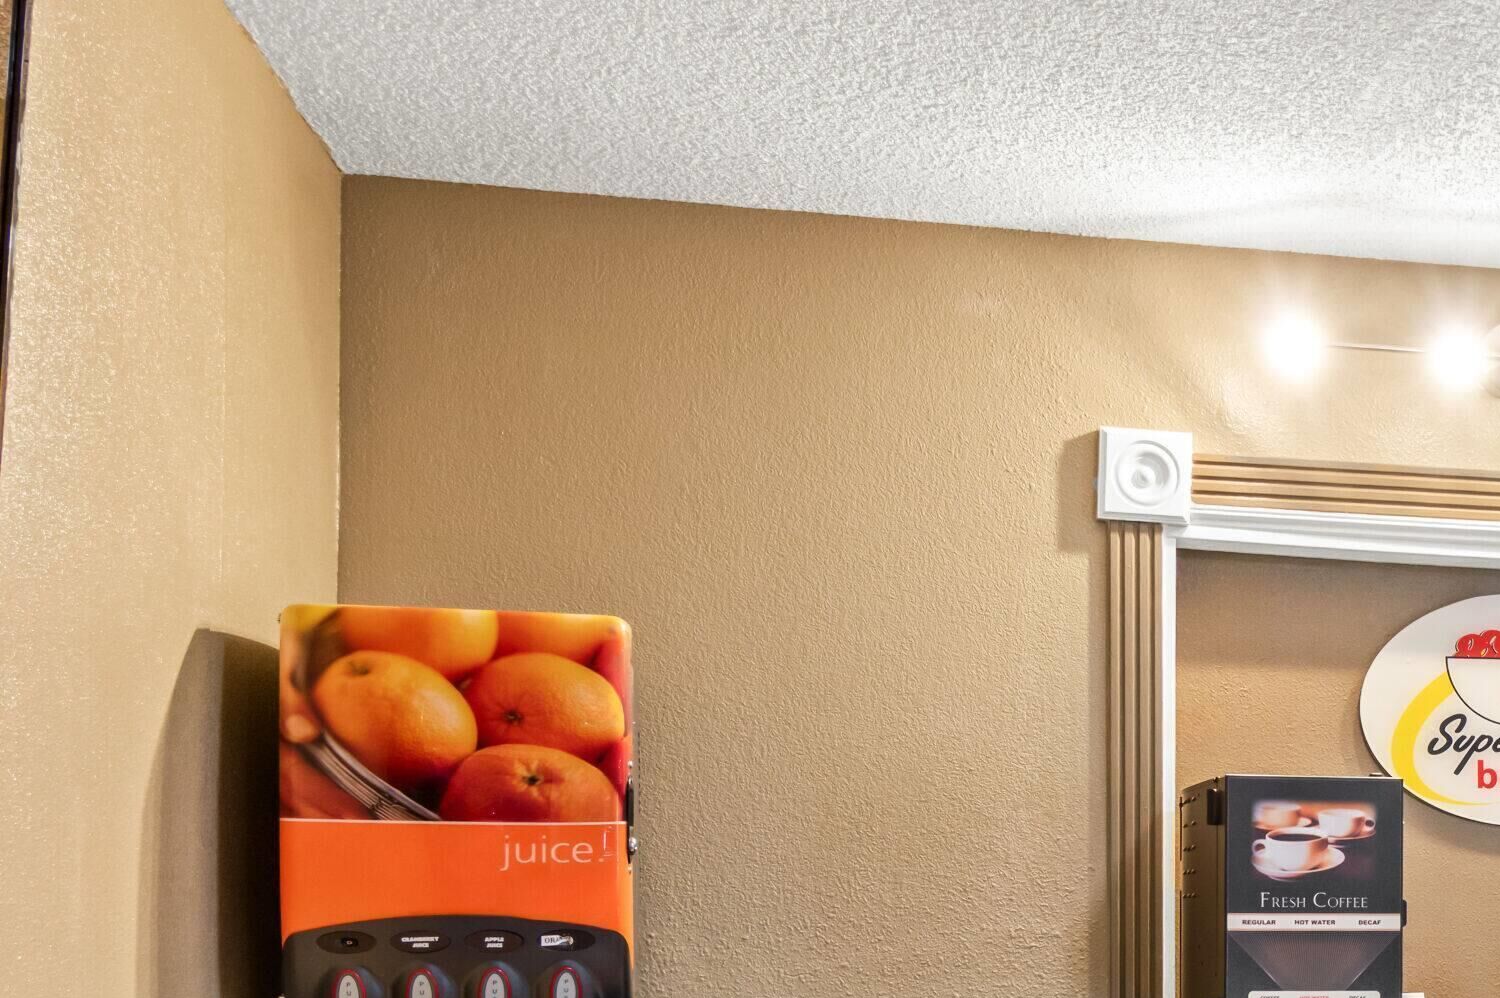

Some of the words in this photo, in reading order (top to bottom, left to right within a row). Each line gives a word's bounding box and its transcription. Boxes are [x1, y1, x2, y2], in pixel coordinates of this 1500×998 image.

[1260, 891, 1306, 908] FRESH
[1313, 891, 1369, 908] COFFEE
[1294, 918, 1310, 926] HOT
[1311, 918, 1336, 926] WATER
[1358, 918, 1382, 926] DECAF
[401, 936, 439, 944] CRANBERRY
